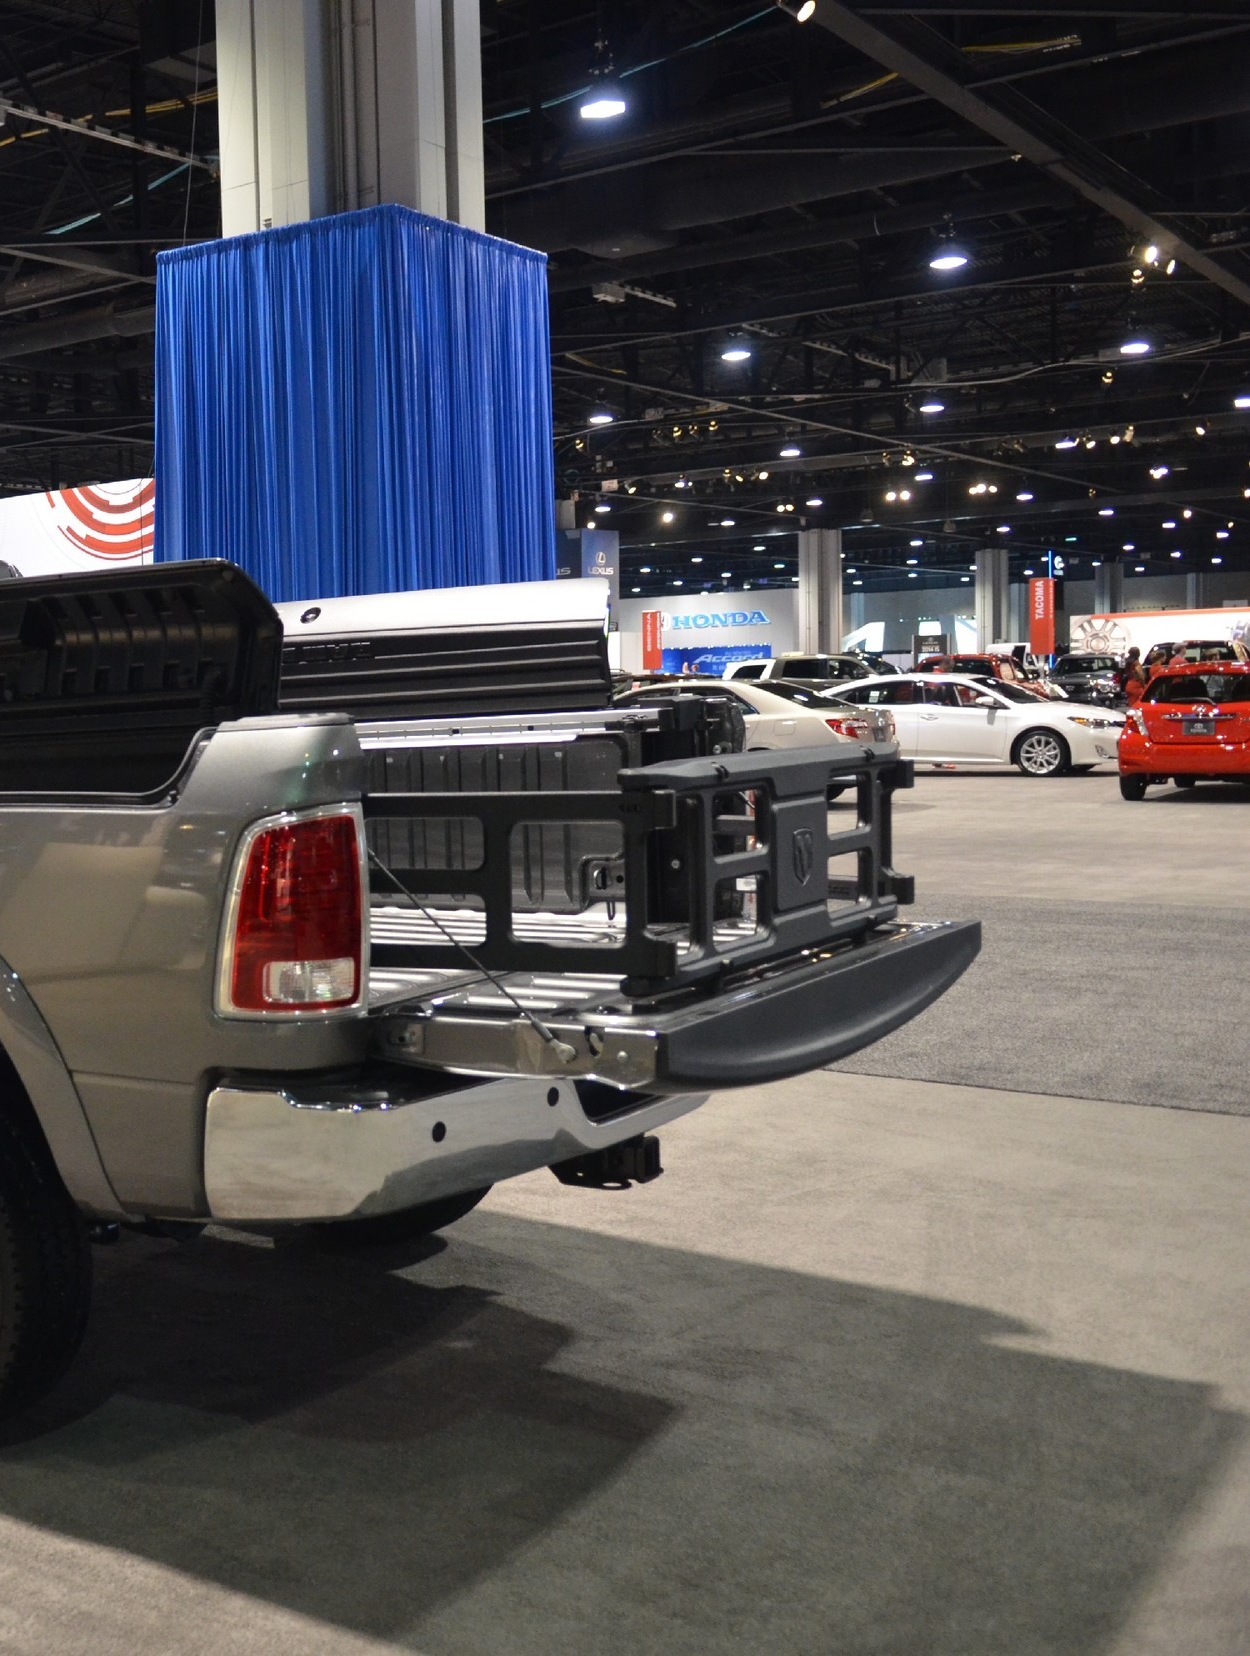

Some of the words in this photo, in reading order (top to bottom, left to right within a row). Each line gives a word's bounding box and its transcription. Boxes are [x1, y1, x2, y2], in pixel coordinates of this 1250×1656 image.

[588, 566, 614, 575] LEXUS
[1034, 580, 1044, 620] TACOMA
[672, 610, 771, 630] HONDA
